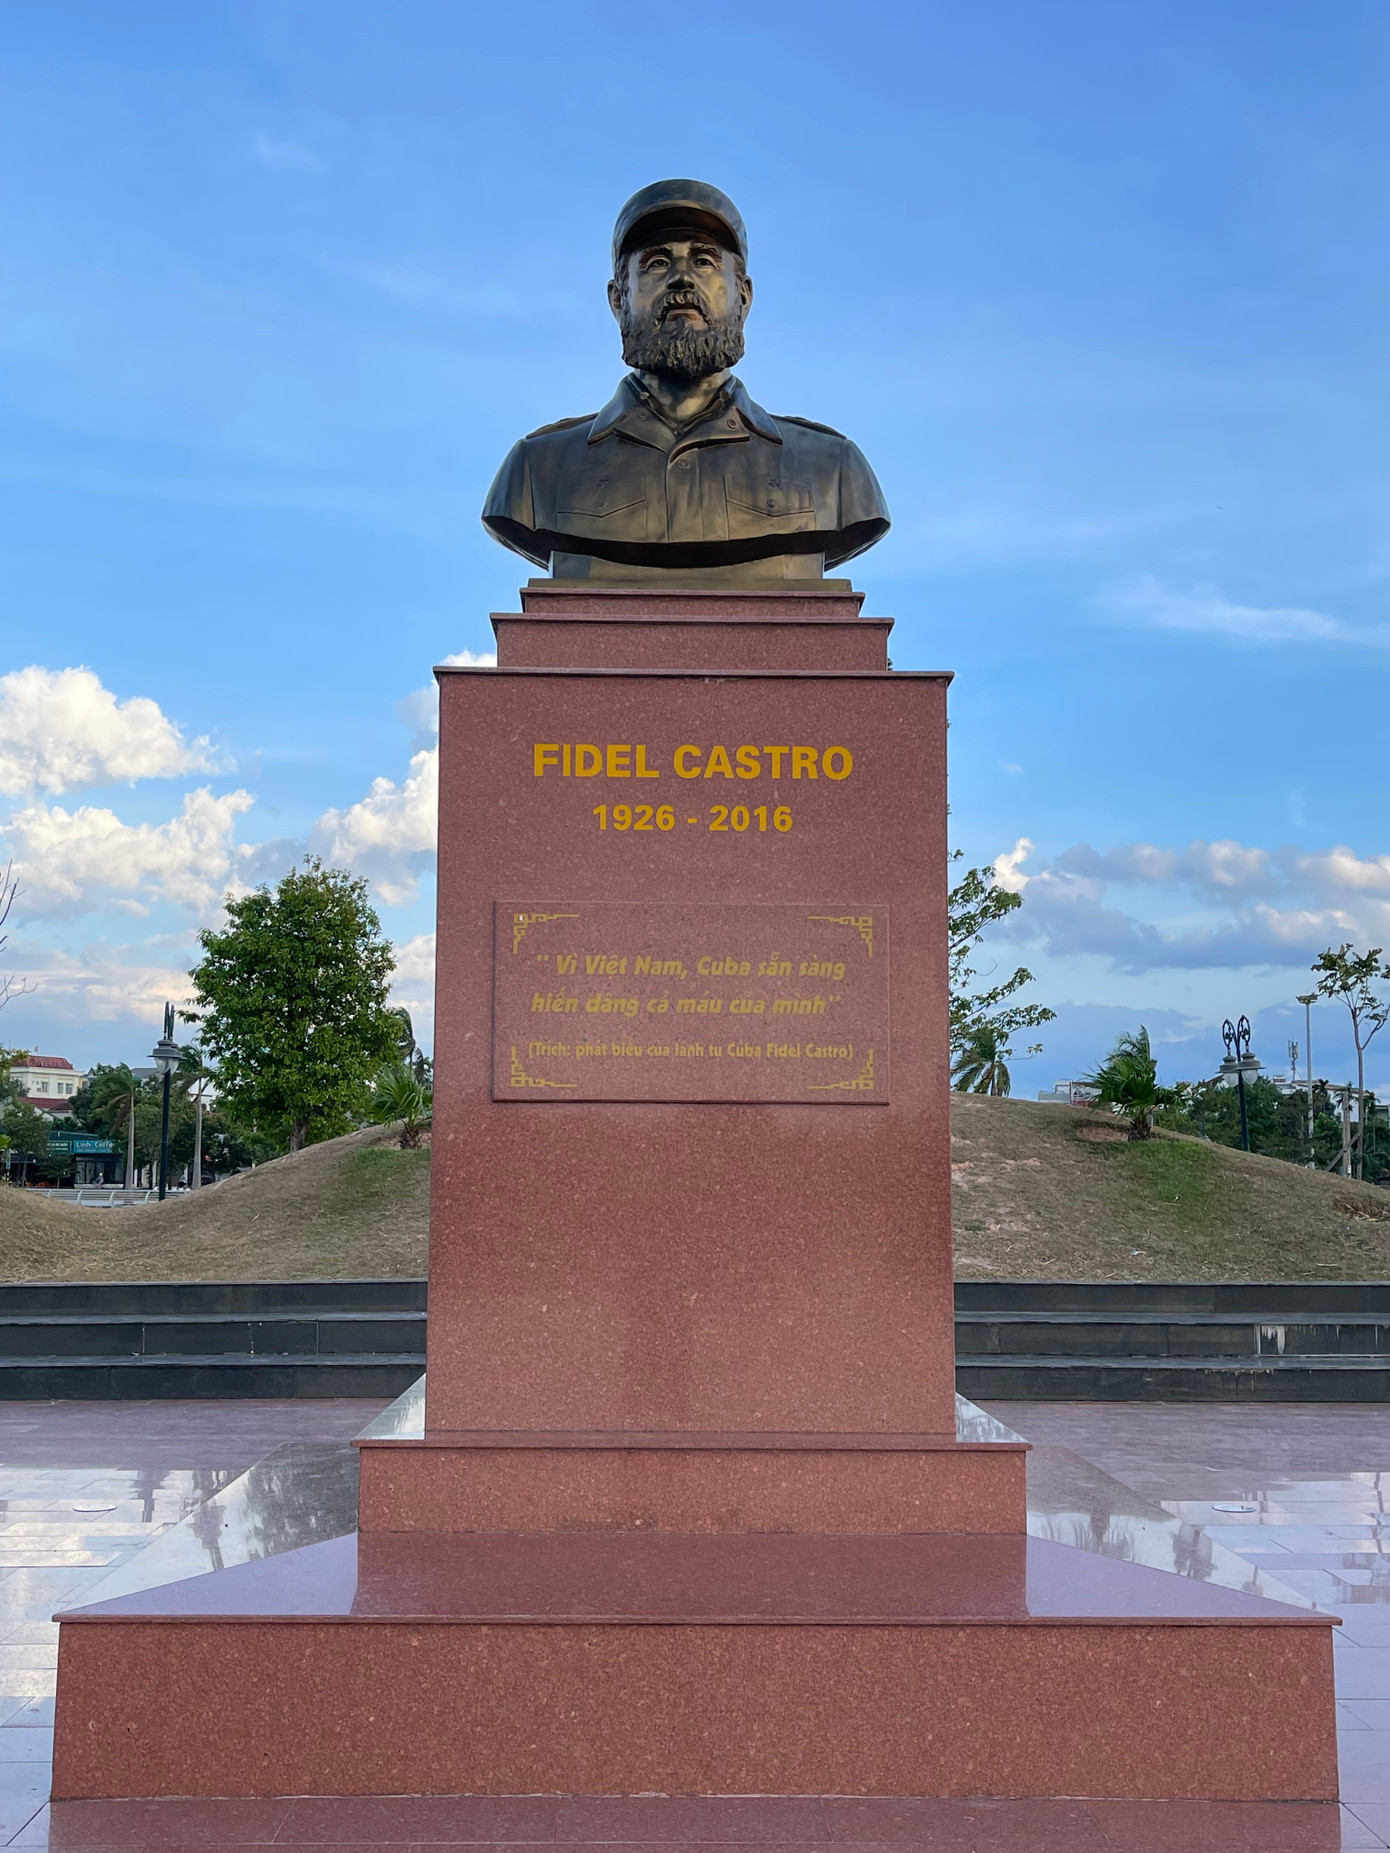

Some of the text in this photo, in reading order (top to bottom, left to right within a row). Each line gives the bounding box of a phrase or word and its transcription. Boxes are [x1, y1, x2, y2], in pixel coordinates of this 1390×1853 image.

[533, 743, 854, 780] FIDEL CASTRO
[593, 804, 676, 831] 1926
[709, 804, 793, 832] 2016
[585, 953, 629, 979] Việt
[633, 955, 689, 980] Nam,
[697, 956, 751, 976] Cuba
[799, 954, 847, 981] sàng
[531, 986, 579, 1013] hiến
[585, 993, 641, 1018] dâng
[675, 991, 723, 1014] máu
[726, 1042, 762, 1058] Cuba
[766, 1042, 801, 1058] Fidel
[805, 1043, 855, 1061] Castro)
